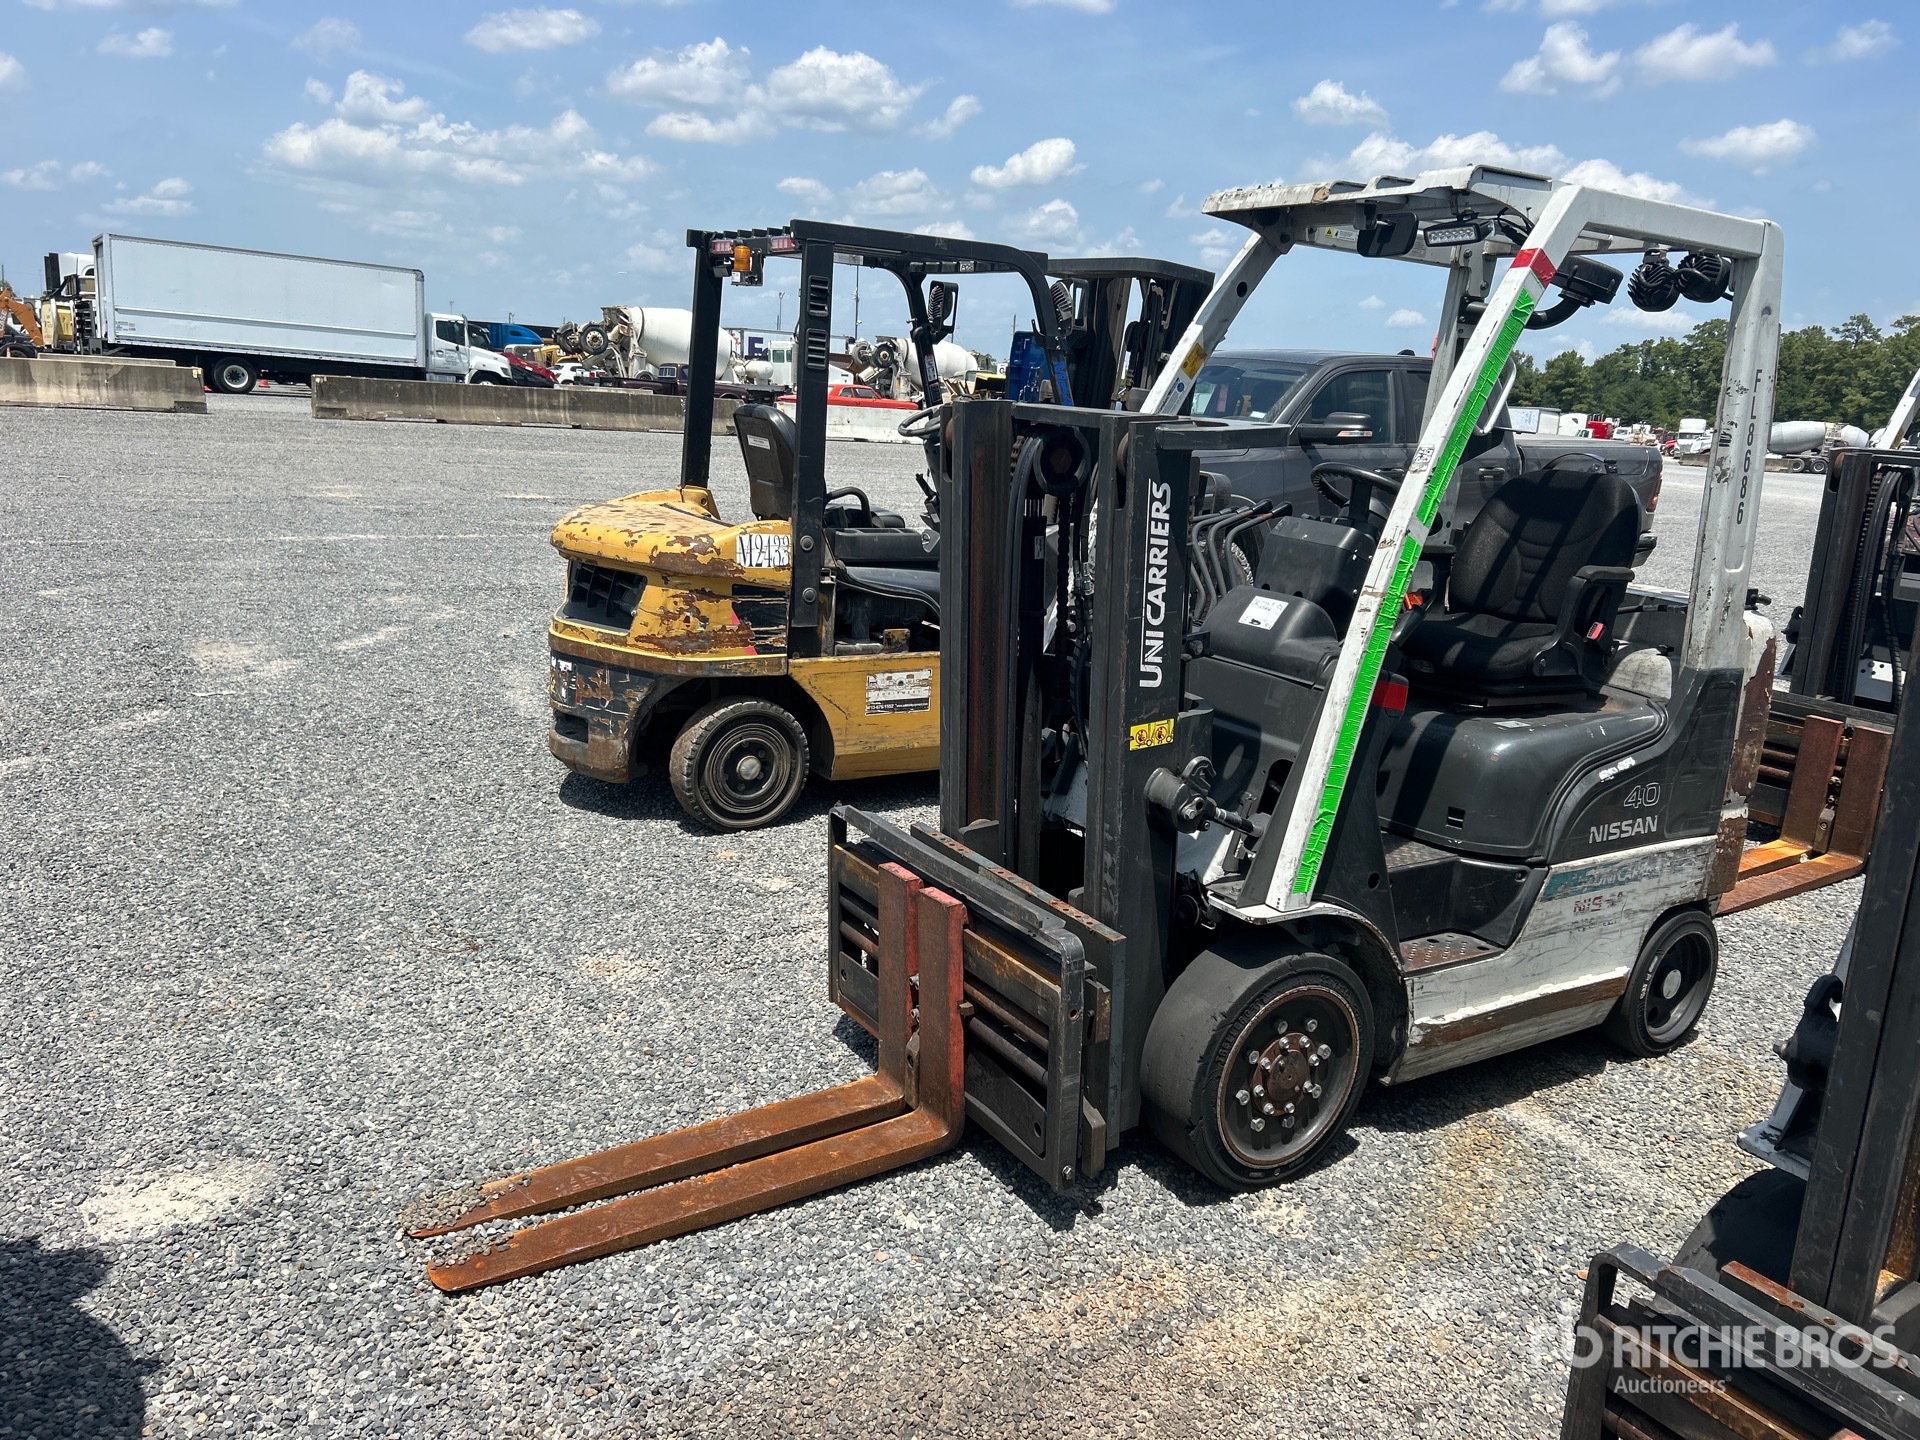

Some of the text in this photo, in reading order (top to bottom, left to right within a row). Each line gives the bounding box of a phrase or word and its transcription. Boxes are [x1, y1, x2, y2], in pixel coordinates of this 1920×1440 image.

[1736, 369, 1763, 525] FL8686
[1623, 782, 1661, 808] 40
[1588, 814, 1658, 844] NISSAN
